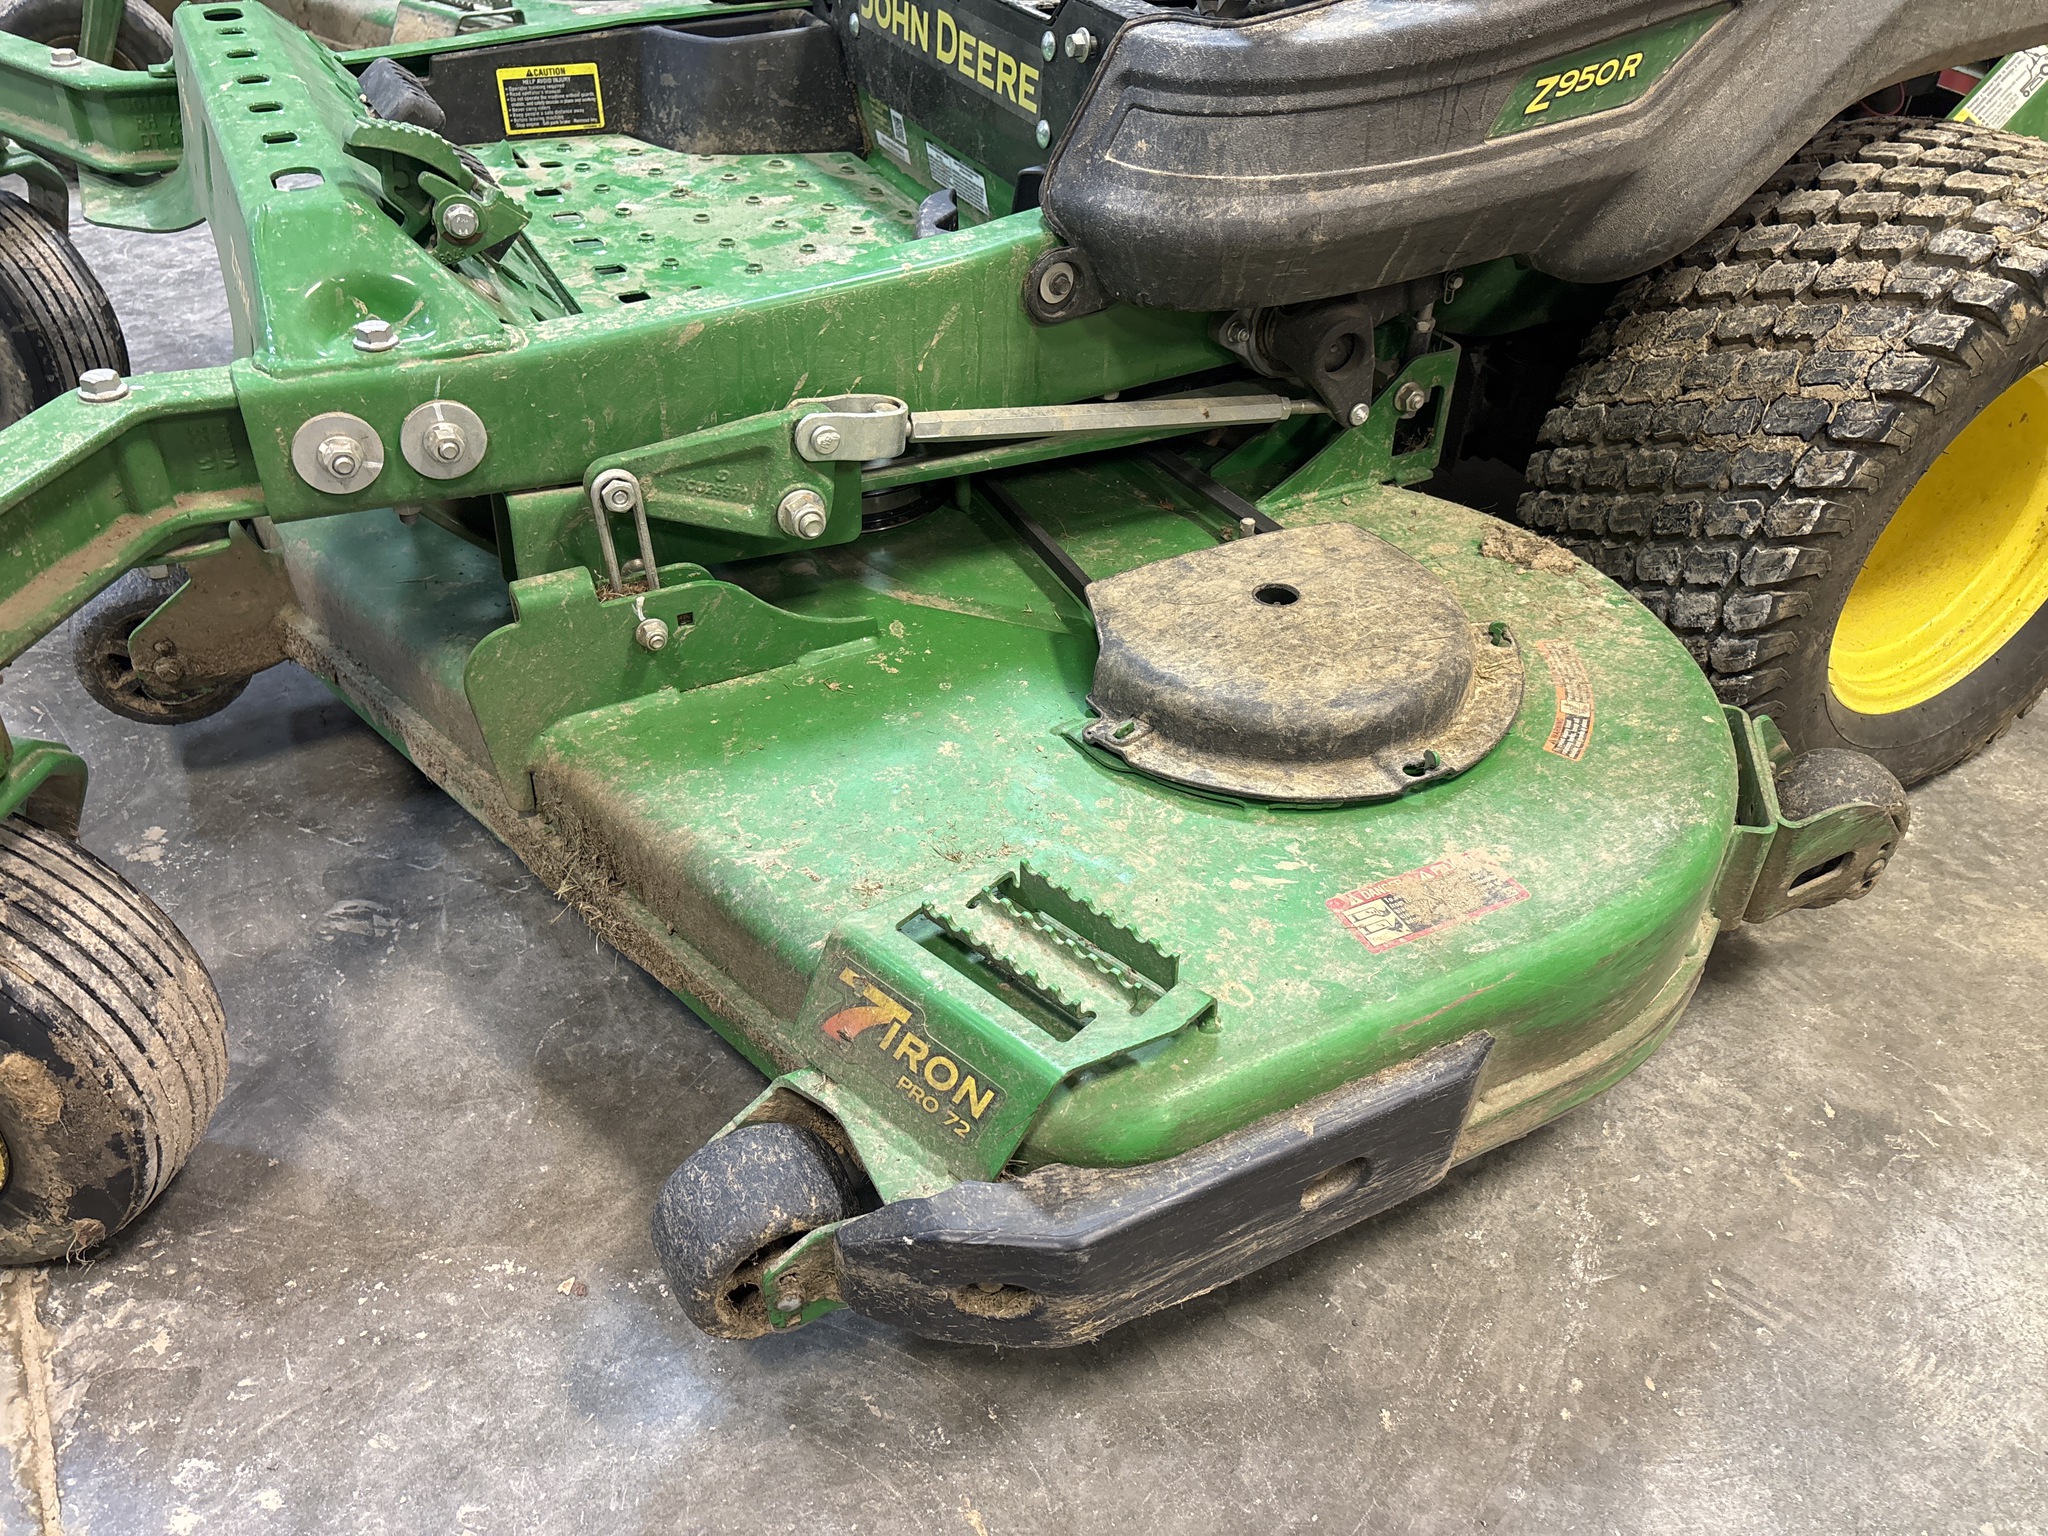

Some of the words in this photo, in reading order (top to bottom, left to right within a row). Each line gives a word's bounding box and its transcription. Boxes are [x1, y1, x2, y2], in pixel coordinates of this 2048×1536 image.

[534, 68, 565, 76] CAUTION
[861, 0, 929, 53] JOHN
[937, 9, 1040, 115] DEERE
[1523, 52, 1644, 115] Z950R
[879, 1022, 995, 1120] IRON
[896, 1075, 940, 1113] PRO
[942, 1110, 971, 1139] 72
